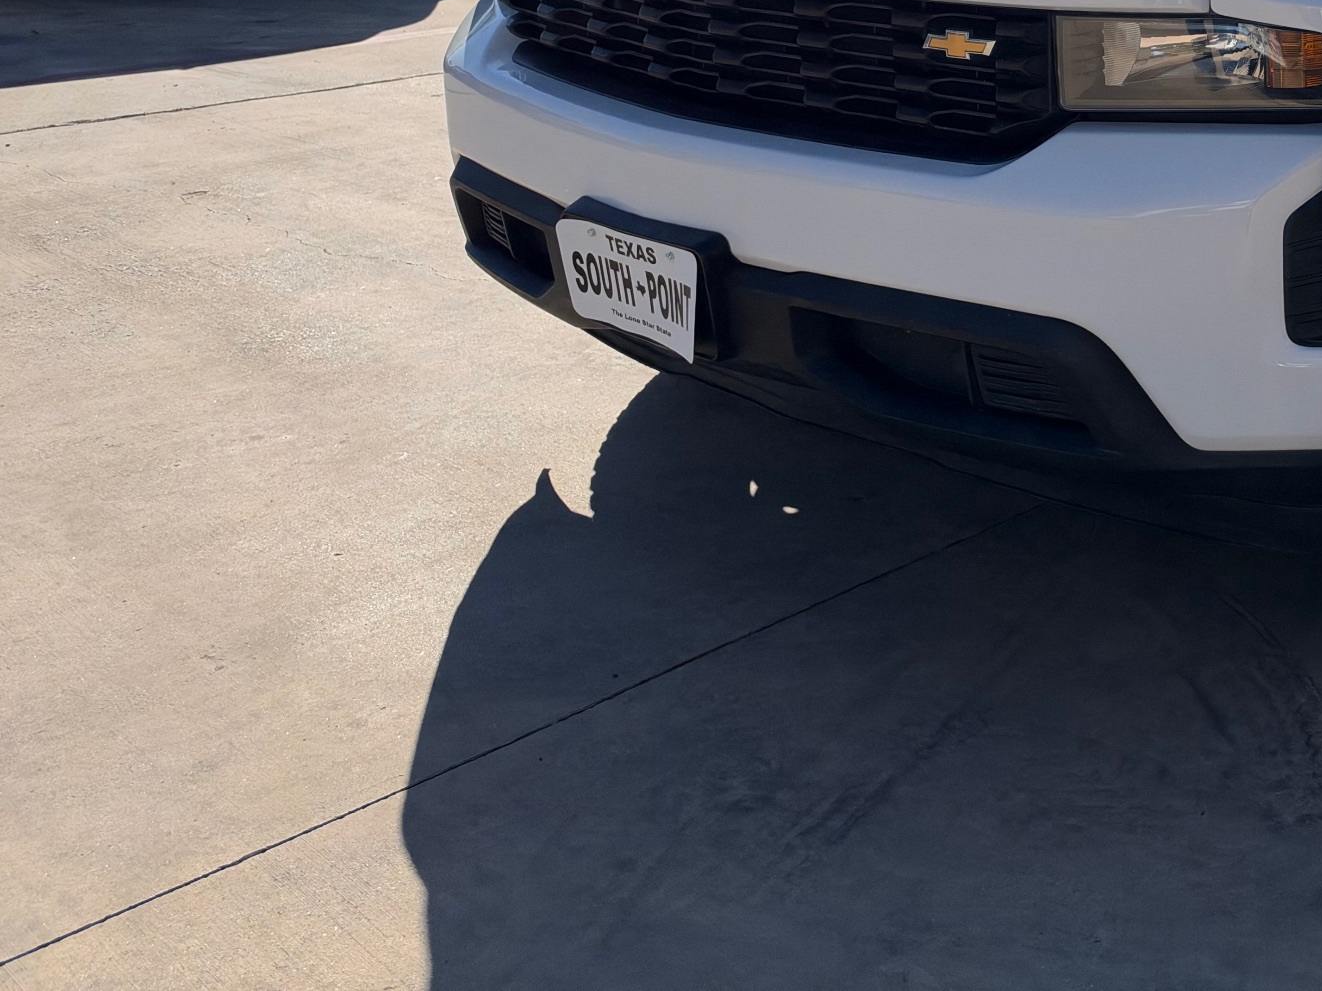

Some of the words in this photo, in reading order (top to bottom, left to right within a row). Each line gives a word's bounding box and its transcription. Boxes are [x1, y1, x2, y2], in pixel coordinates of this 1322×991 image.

[604, 234, 657, 265] TEXAS
[572, 250, 636, 307] SOUTH
[645, 270, 692, 331] POINT
[611, 308, 624, 318] The
[624, 313, 641, 324] Lone
